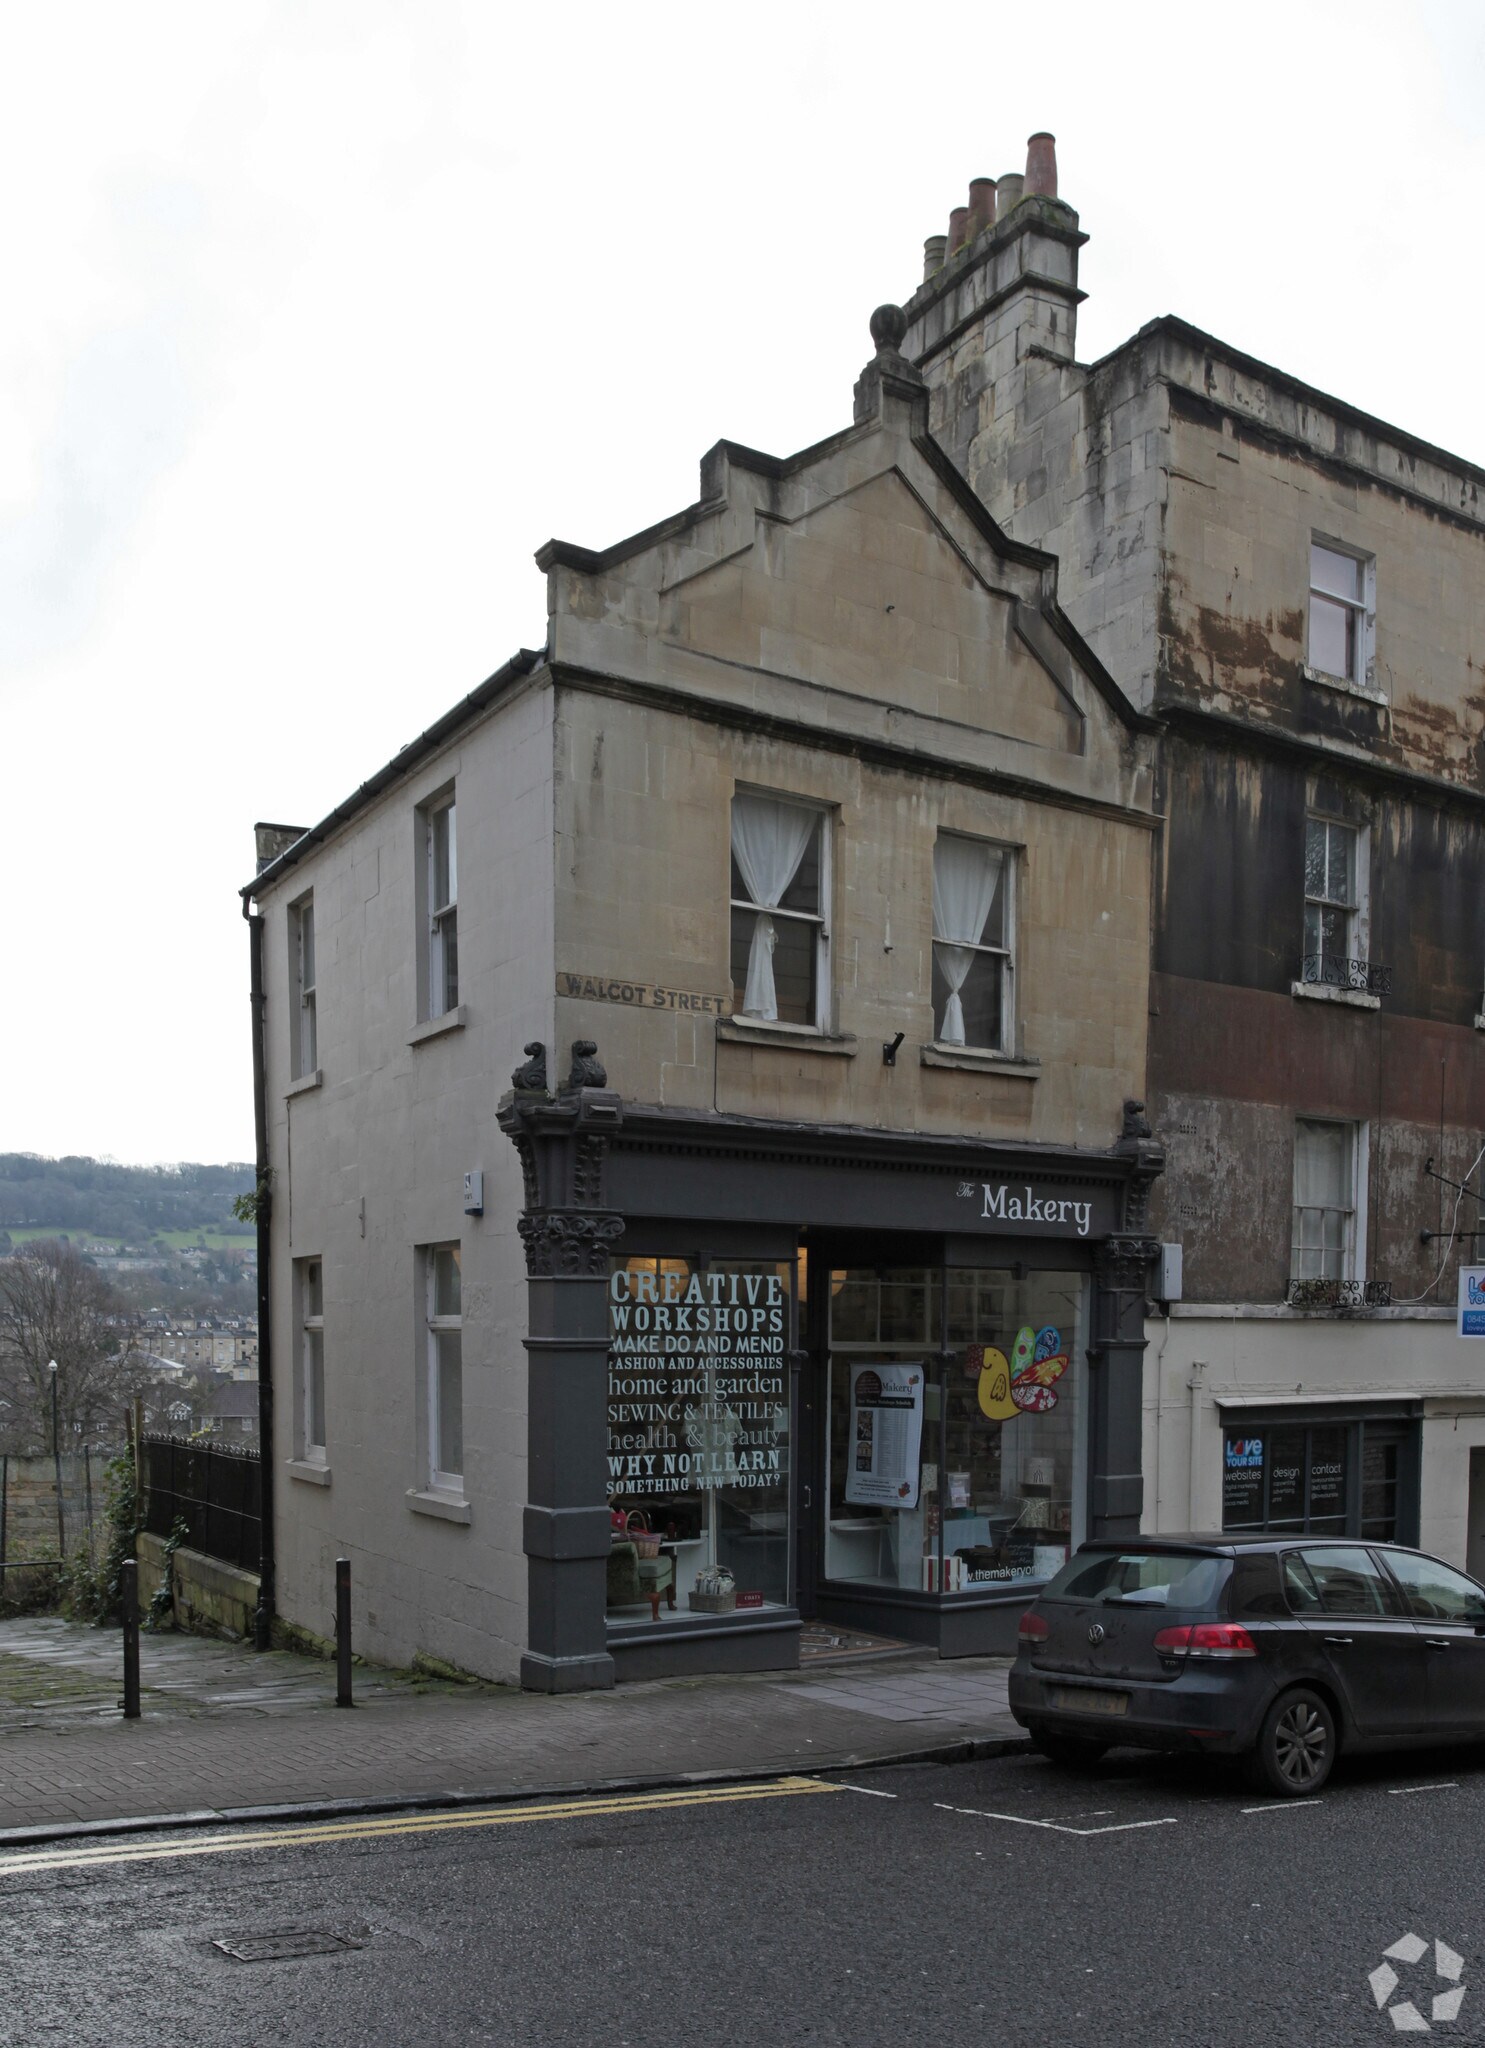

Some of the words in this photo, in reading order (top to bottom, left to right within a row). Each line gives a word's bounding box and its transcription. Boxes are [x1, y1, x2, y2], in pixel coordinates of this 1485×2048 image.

[566, 975, 646, 1004] WALCOT
[653, 988, 725, 1014] STREET
[956, 1181, 976, 1198] The
[981, 1184, 1092, 1236] Makery
[610, 1270, 783, 1306] CREATIVE
[609, 1305, 783, 1333] WORKSHOPS
[609, 1335, 660, 1353] MAKE
[665, 1335, 691, 1353] DO
[694, 1335, 732, 1354] AND
[735, 1336, 784, 1354] MEND
[668, 1357, 695, 1370] AND
[697, 1357, 783, 1370] ACCESSORIES
[607, 1372, 668, 1395] home
[672, 1372, 710, 1395] and
[714, 1372, 783, 1401] garden
[883, 1382, 912, 1394] Makery
[607, 1403, 681, 1422] SEWING
[684, 1402, 696, 1421] &
[700, 1401, 783, 1420] TEXTILES
[606, 1425, 677, 1450] health
[685, 1424, 705, 1448] &
[712, 1423, 782, 1447] beauty
[606, 1454, 657, 1477] WHY
[663, 1452, 705, 1474] NOT
[712, 1449, 781, 1472] LEARN
[1226, 1457, 1247, 1467] YOUR
[1248, 1456, 1263, 1466] SITE
[1312, 1464, 1341, 1475] contact
[1224, 1469, 1262, 1481] websites
[1273, 1466, 1300, 1480] design
[606, 1477, 690, 1495] SOMETHING
[695, 1476, 725, 1490] NEW
[732, 1473, 781, 1489] TODAY?
